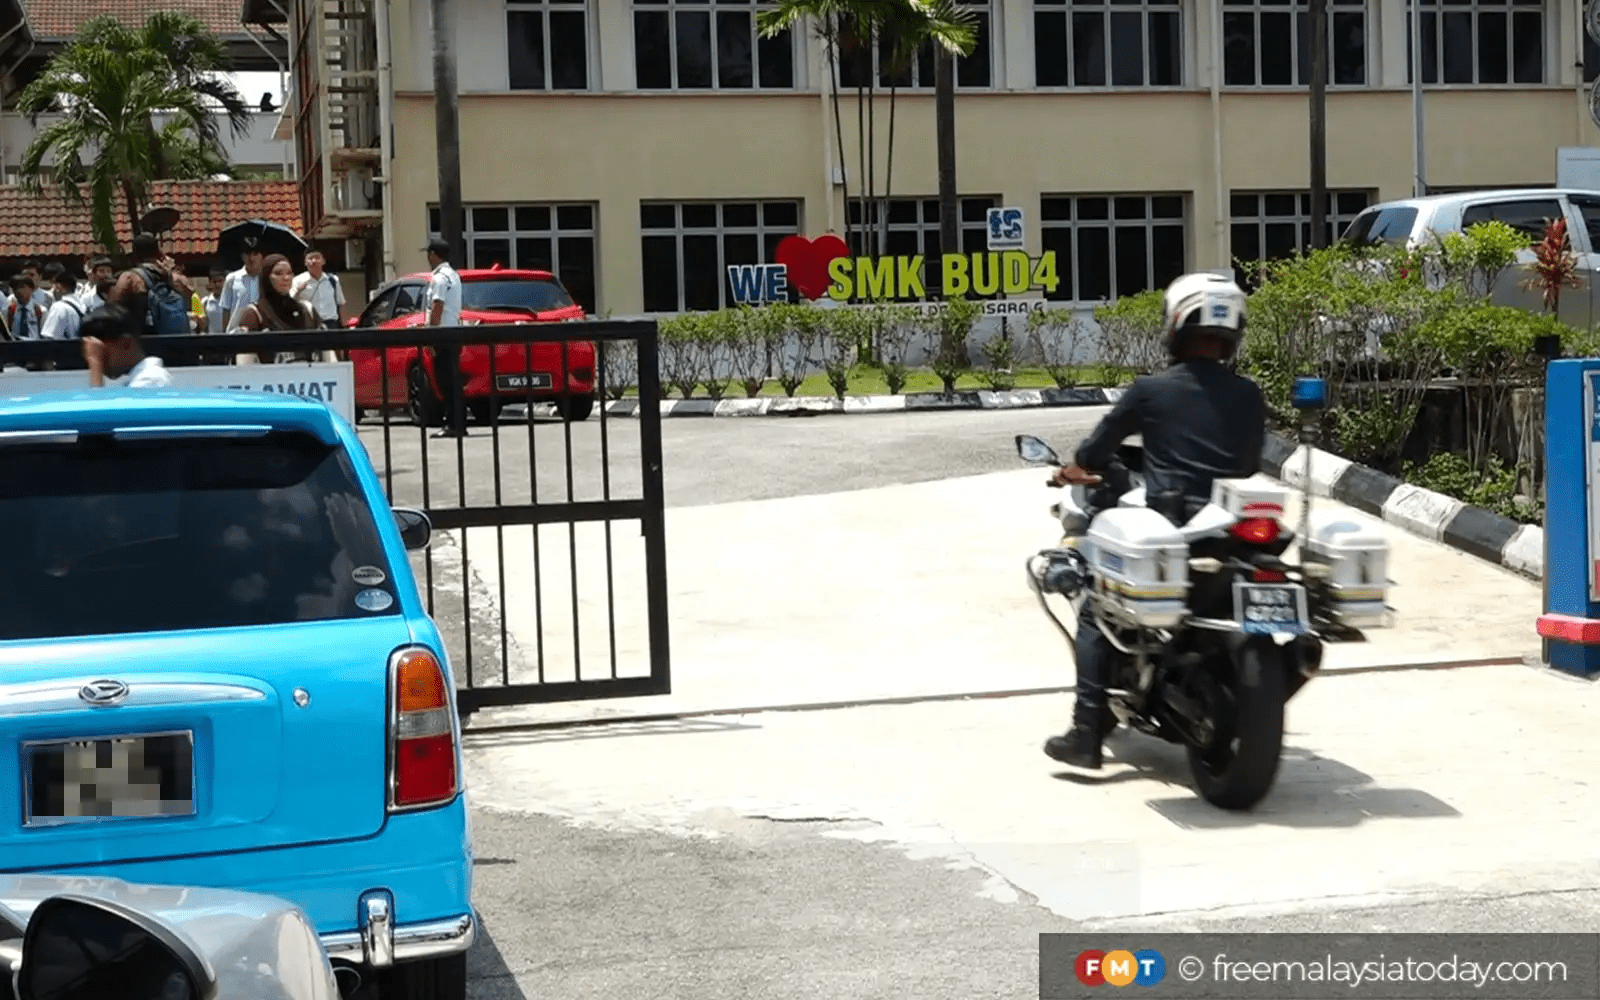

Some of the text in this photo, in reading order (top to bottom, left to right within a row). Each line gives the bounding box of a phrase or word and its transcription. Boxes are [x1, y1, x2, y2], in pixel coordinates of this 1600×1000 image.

[727, 250, 1060, 304] WE SMK BUD4
